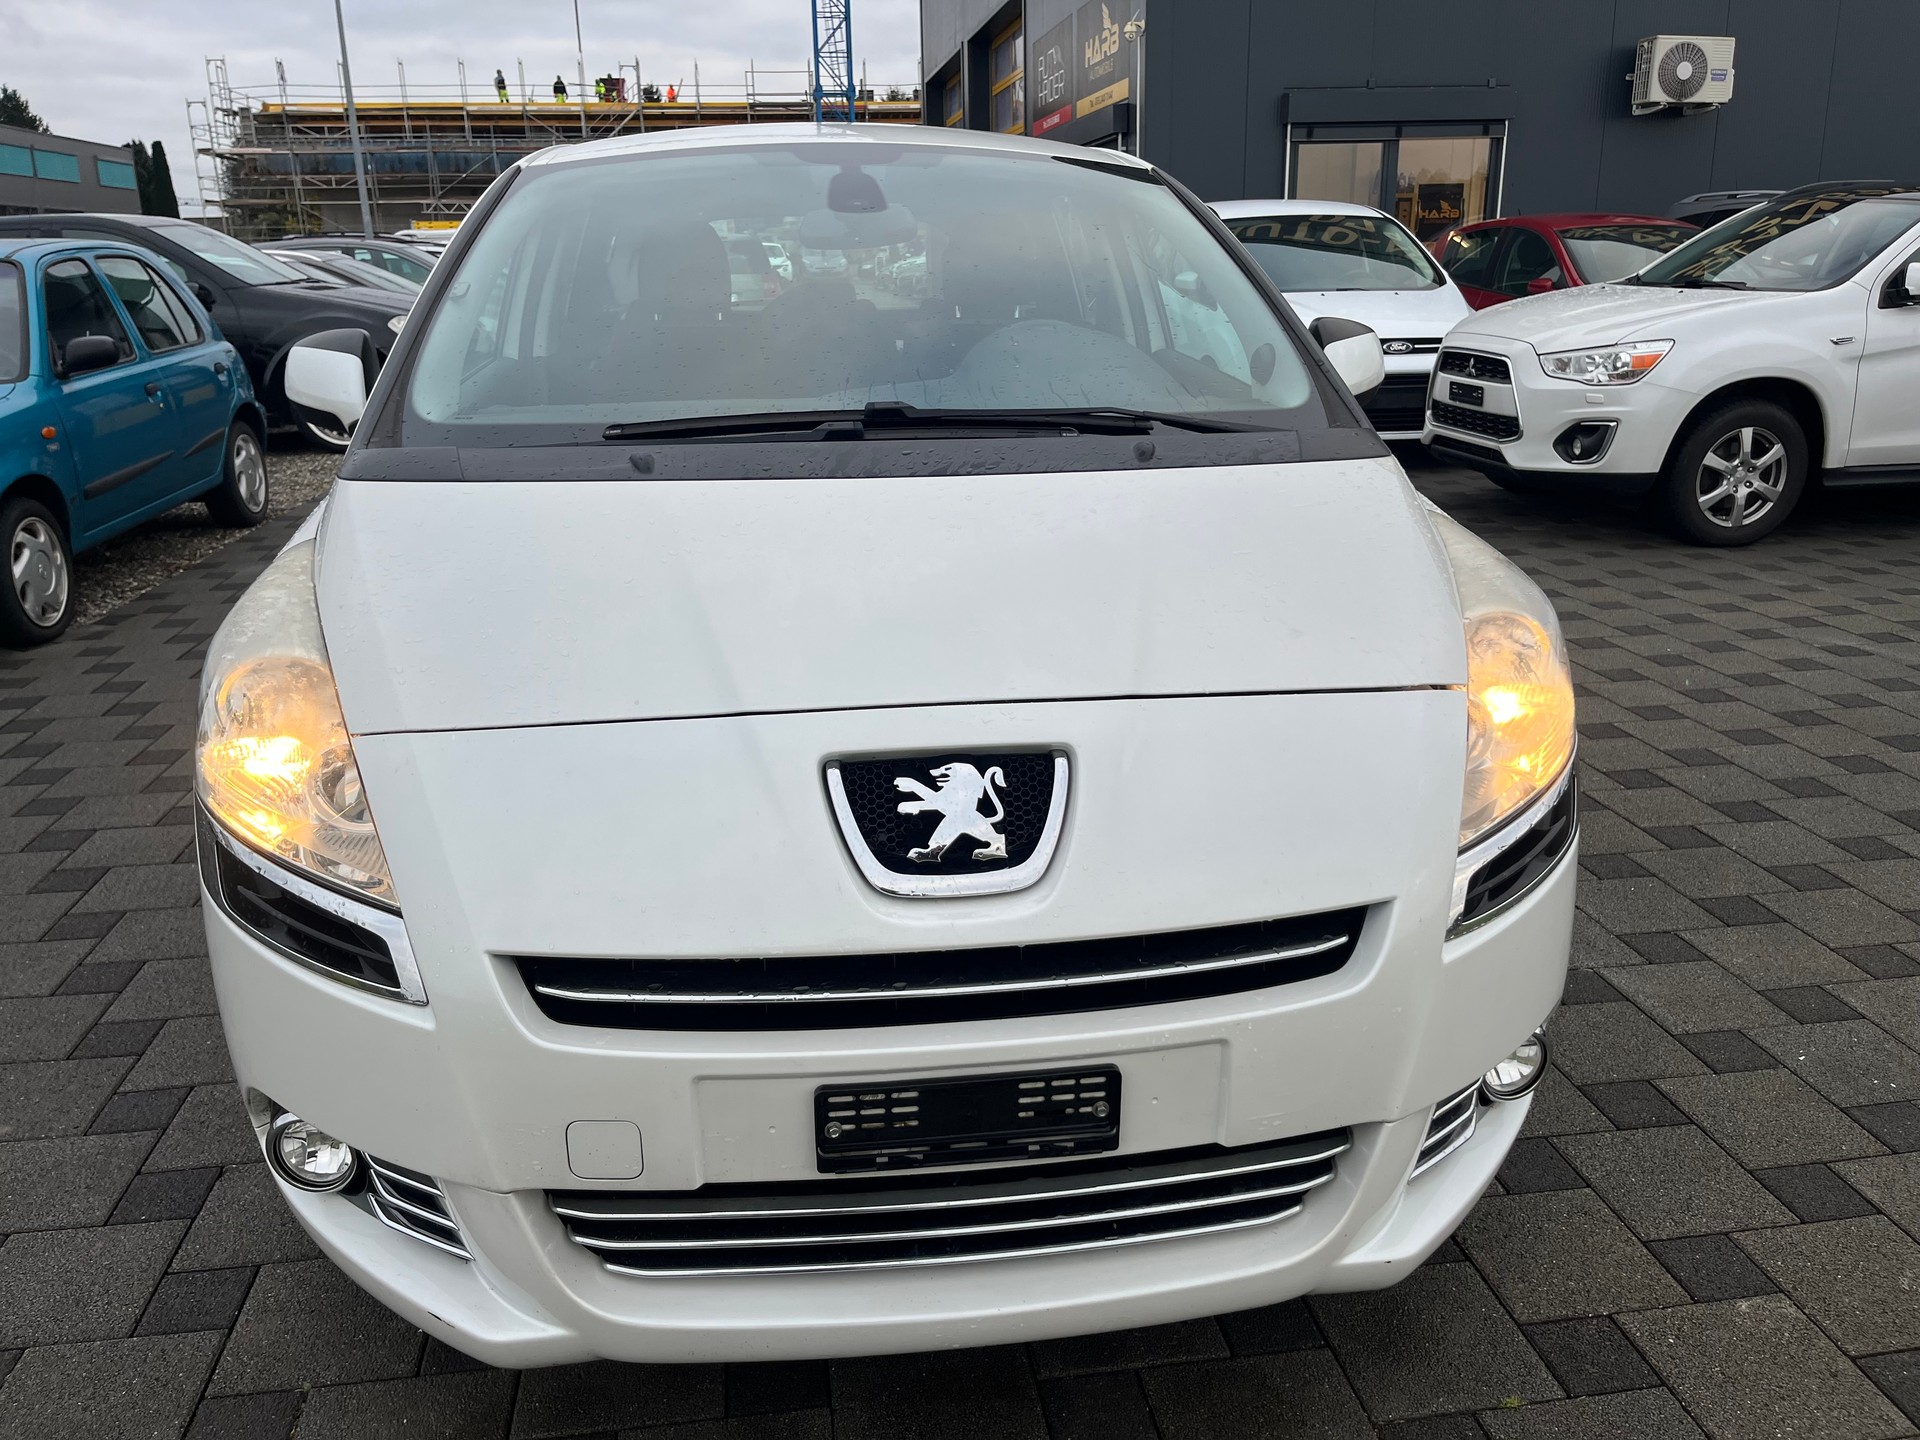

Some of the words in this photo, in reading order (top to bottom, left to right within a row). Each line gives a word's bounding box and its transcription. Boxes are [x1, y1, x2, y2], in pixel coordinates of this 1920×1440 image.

[1085, 23, 1119, 68] HARB
[1419, 208, 1460, 219] HARB
[1389, 343, 1407, 351] Ford
